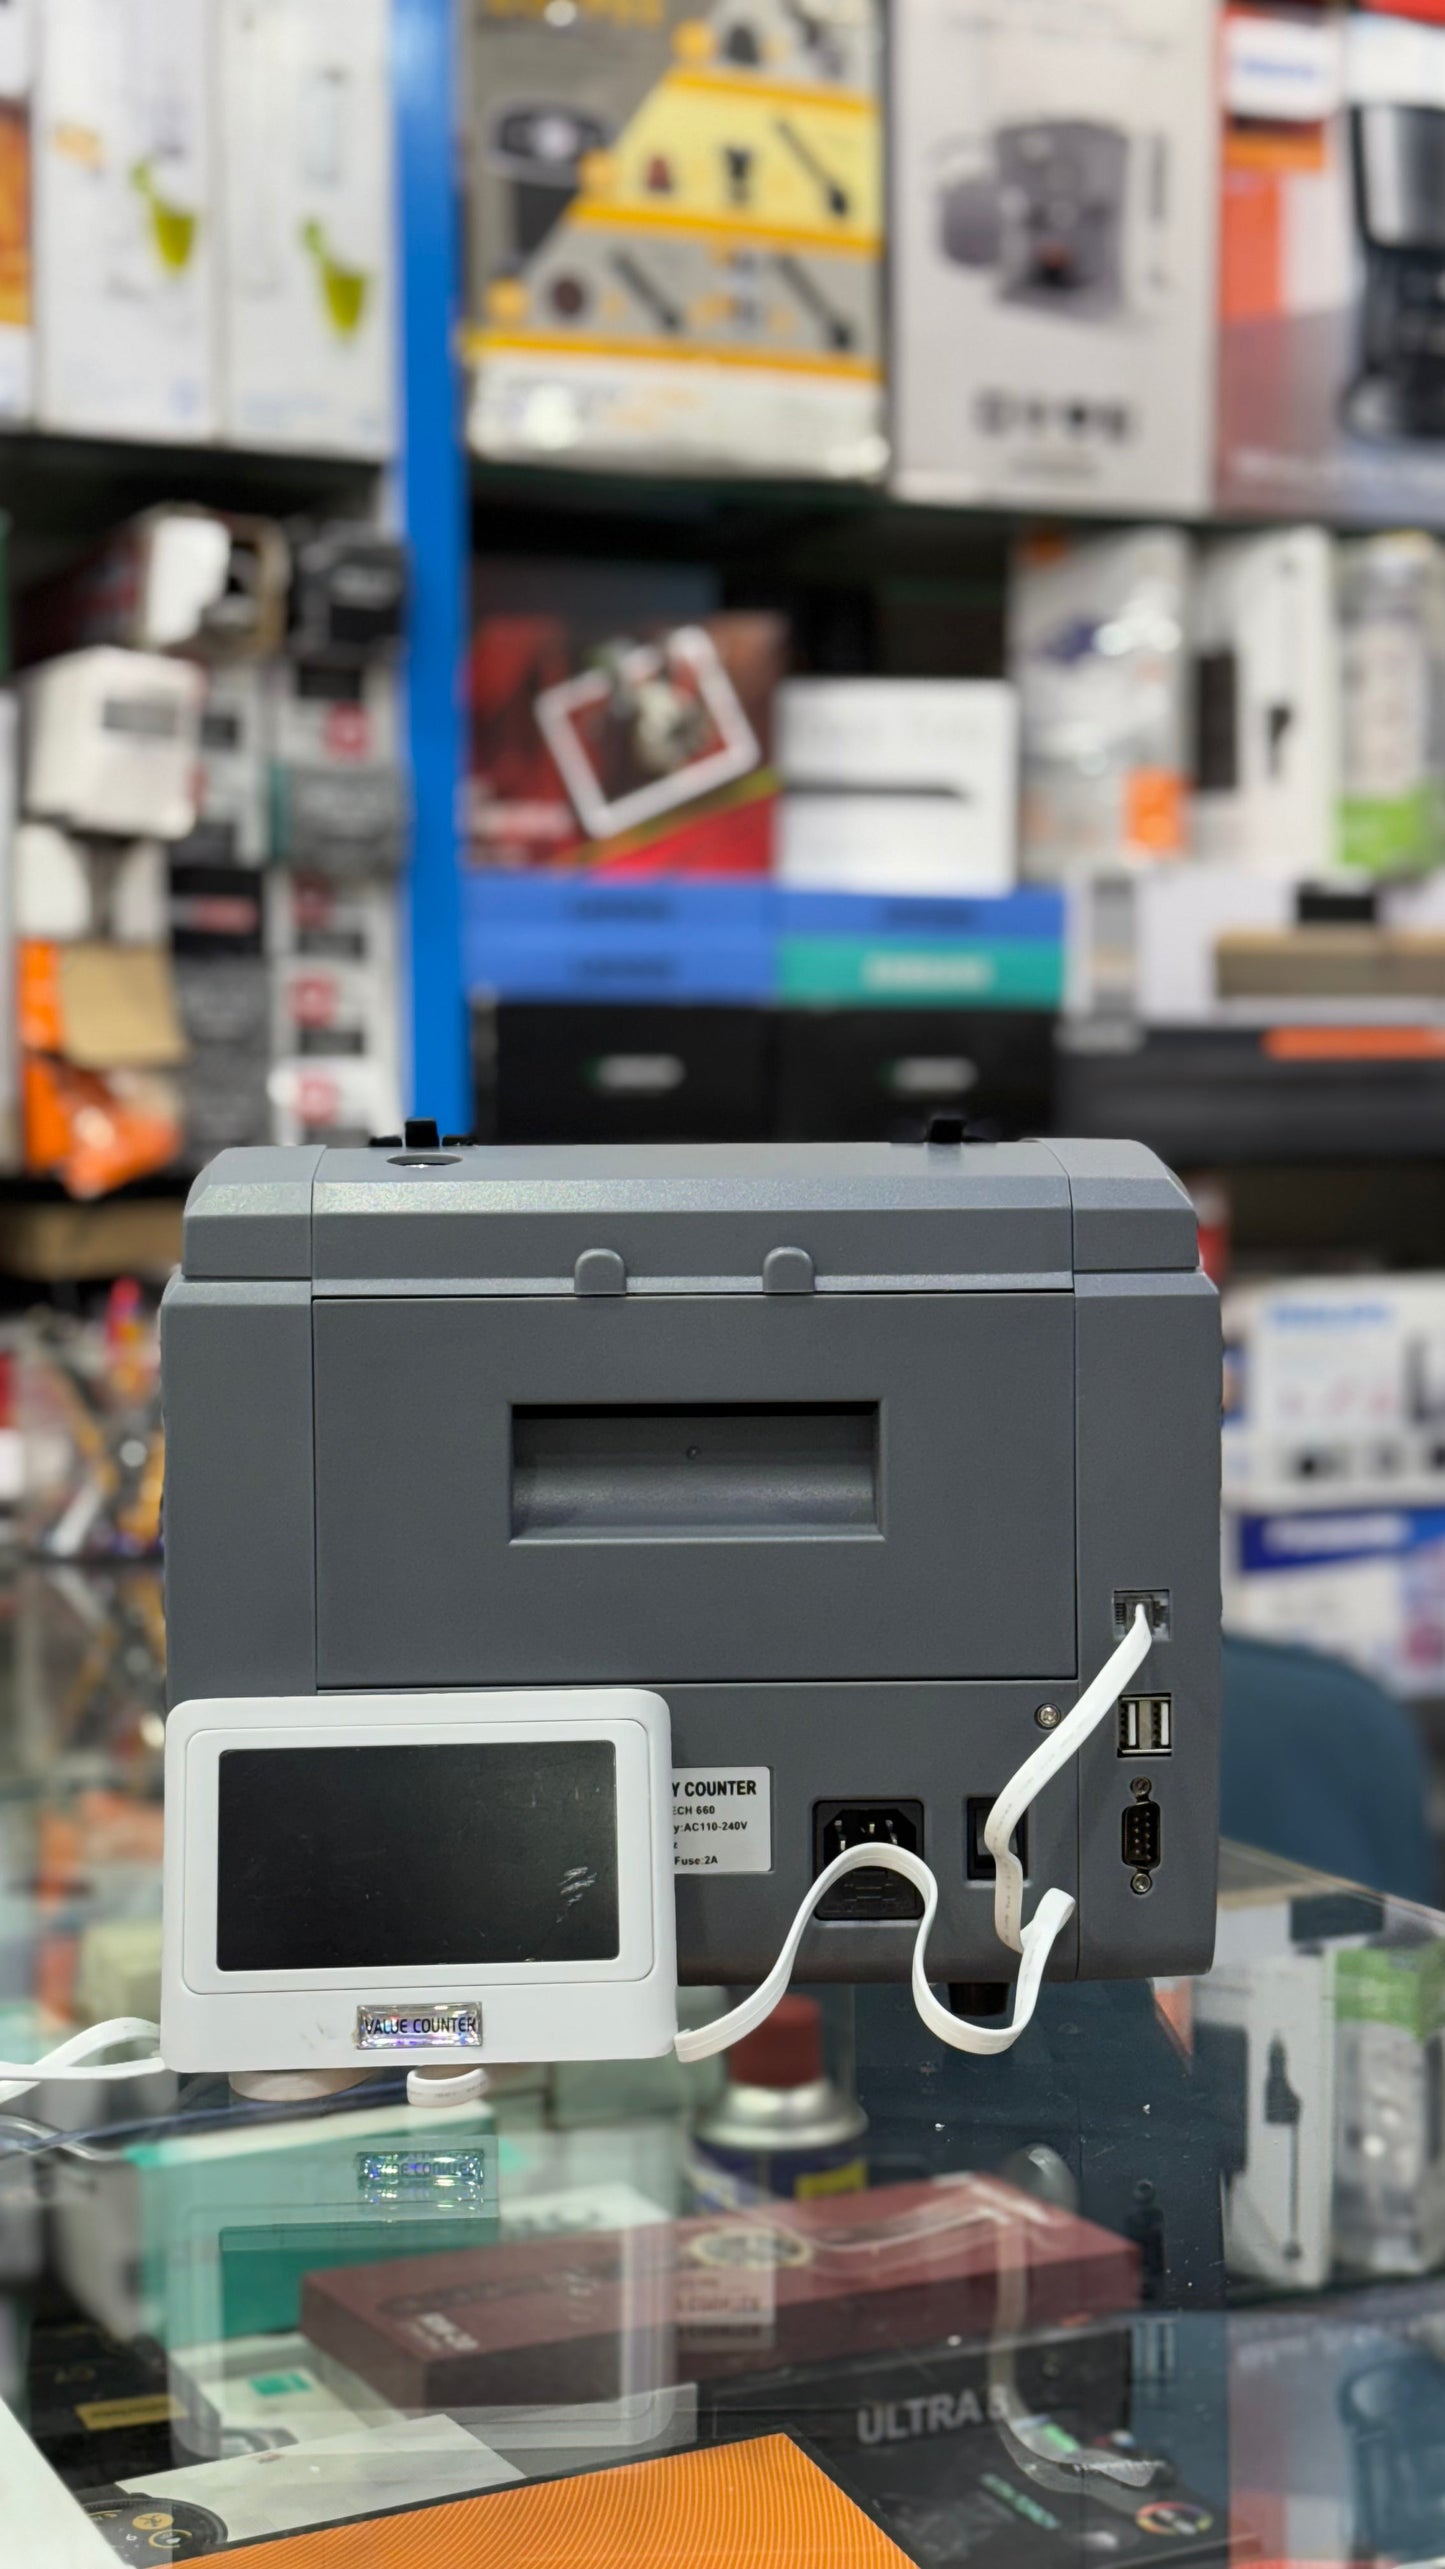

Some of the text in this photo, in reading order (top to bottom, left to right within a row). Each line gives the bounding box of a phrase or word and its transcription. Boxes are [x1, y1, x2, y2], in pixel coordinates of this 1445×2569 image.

[684, 1780, 757, 1797] COUNTER
[696, 1805, 715, 1815] 660
[364, 2016, 477, 2035] VALUE COUNTER
[857, 2388, 984, 2445] ULTRA
